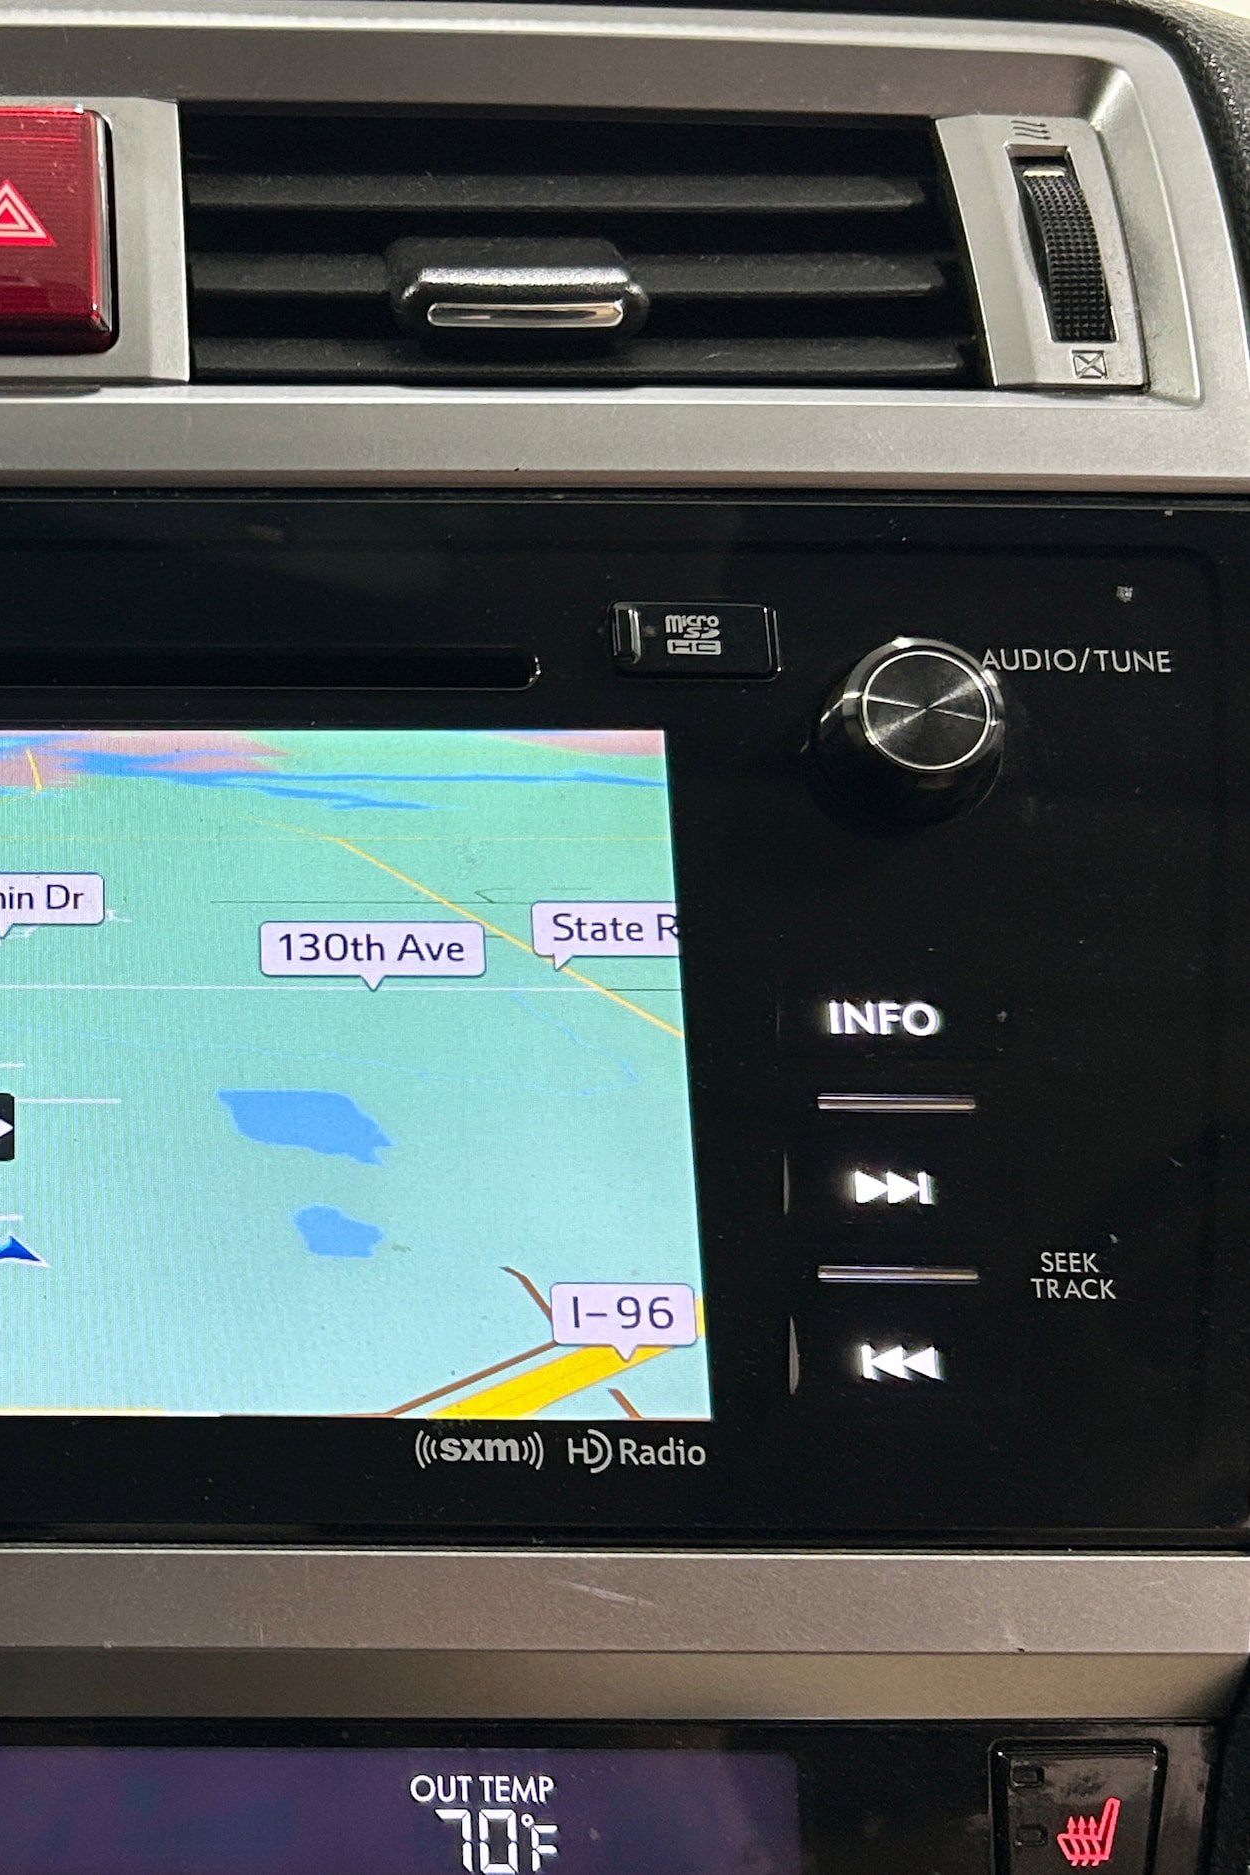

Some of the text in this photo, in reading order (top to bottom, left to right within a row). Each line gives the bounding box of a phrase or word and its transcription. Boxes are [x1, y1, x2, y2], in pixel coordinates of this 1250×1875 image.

[981, 647, 1172, 673] AUDIO/TUNE
[46, 884, 84, 910] Dr
[552, 913, 644, 942] State
[279, 933, 465, 962] 130th Ave
[828, 1000, 940, 1037] INFO
[1040, 1252, 1100, 1273] SEEK
[1030, 1278, 1117, 1299] TRACK
[572, 1296, 674, 1329] I-96
[618, 1437, 706, 1466] Radio
[410, 1774, 555, 1804] OUT TEMP
